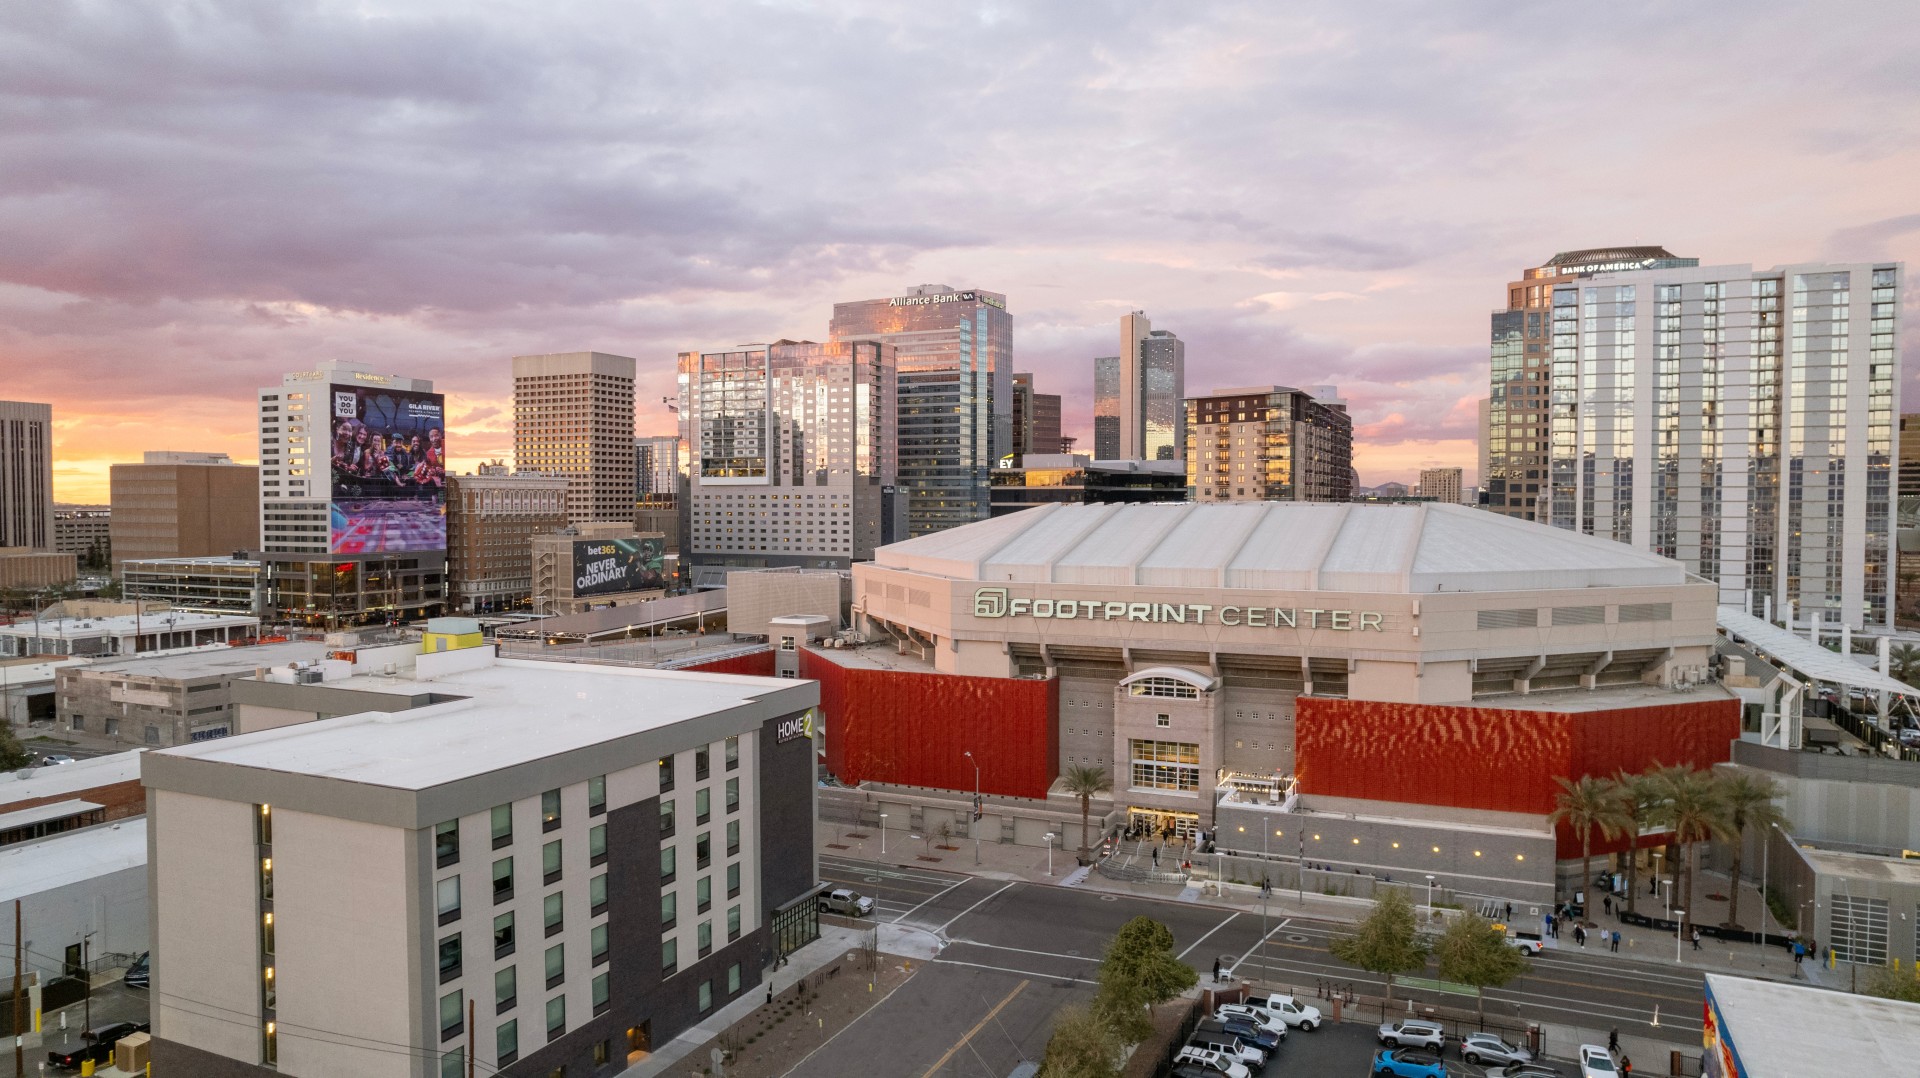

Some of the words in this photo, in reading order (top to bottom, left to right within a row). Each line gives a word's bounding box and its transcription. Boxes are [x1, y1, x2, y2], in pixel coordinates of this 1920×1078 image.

[1562, 266, 1586, 275] BANK
[1600, 262, 1641, 271] AMERICA
[889, 298, 930, 307] Alliance
[933, 294, 960, 303] Bank
[355, 372, 384, 382] Residence
[1000, 459, 1013, 468] EY
[588, 545, 615, 555] bet365
[586, 557, 616, 575] NEVER
[577, 565, 628, 589] ORDINARY
[1010, 599, 1212, 623] FOOTPRINT
[1219, 607, 1382, 632] CENTER
